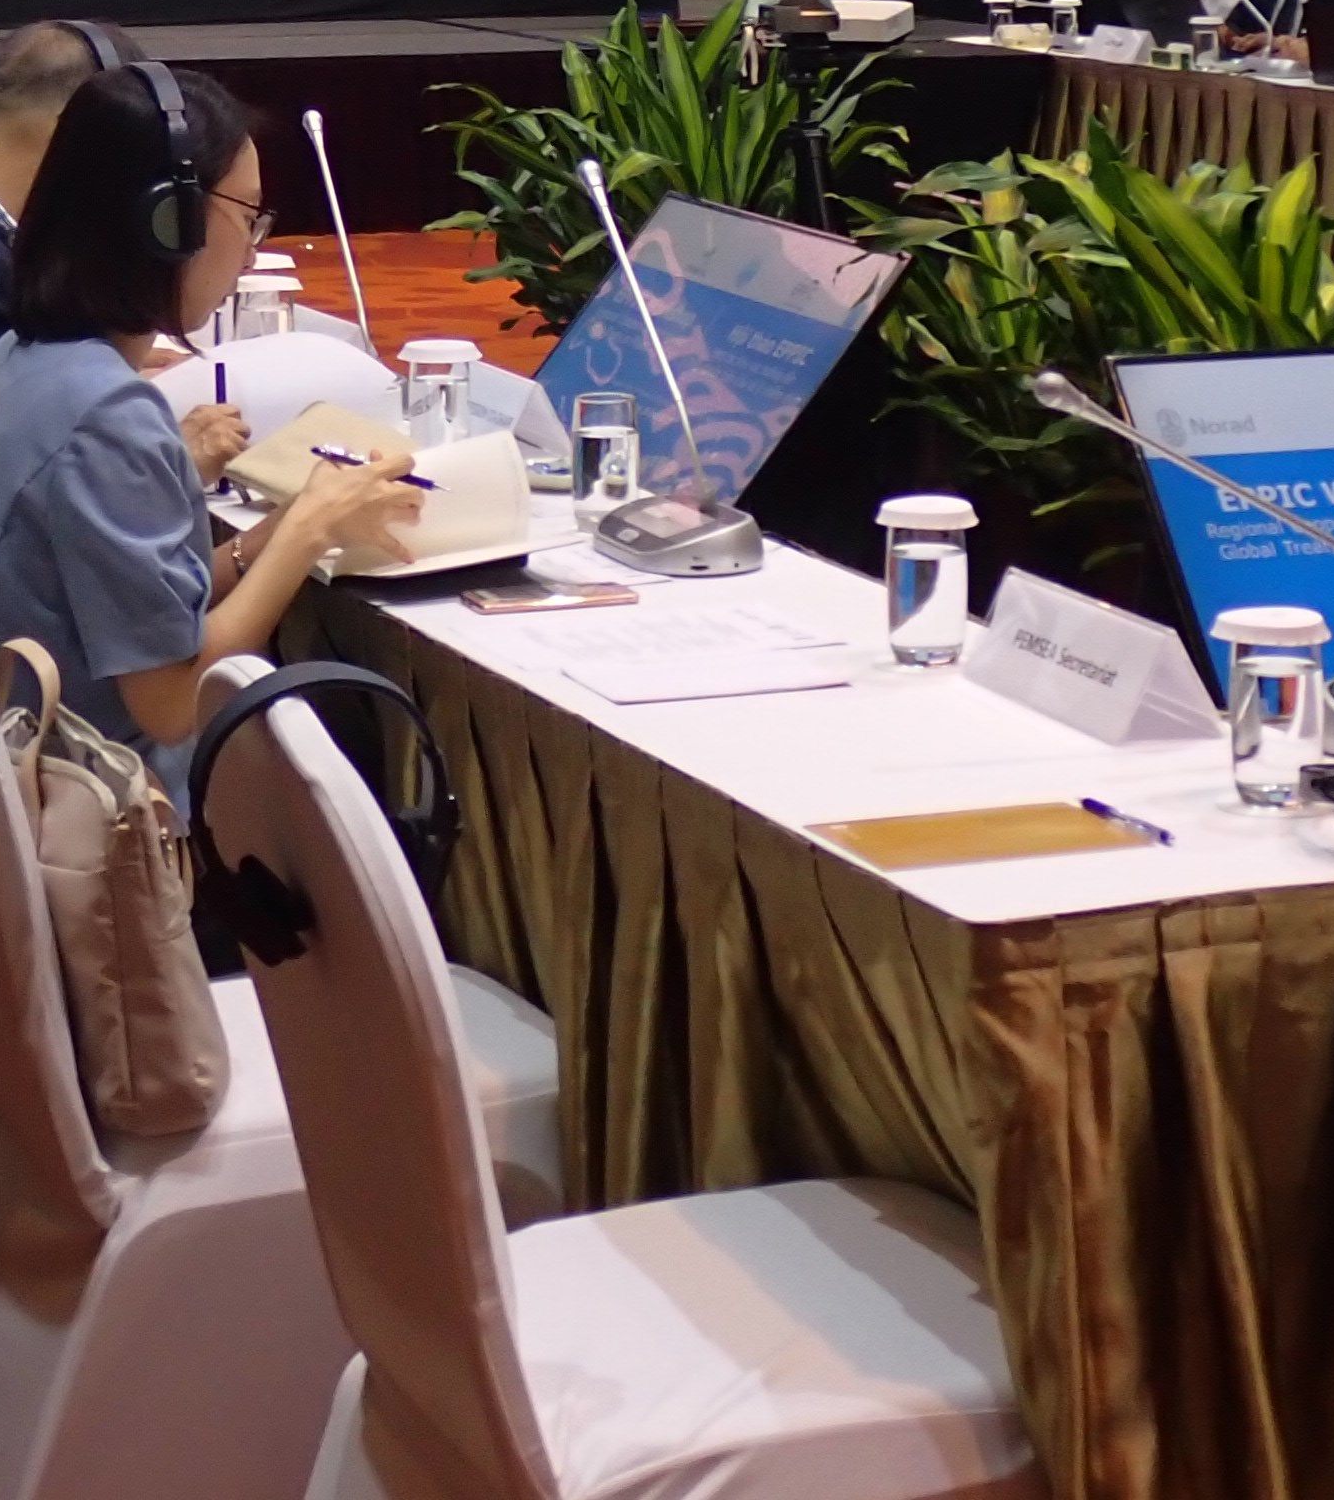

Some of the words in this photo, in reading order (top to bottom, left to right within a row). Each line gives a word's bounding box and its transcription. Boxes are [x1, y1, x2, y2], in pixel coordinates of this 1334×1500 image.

[1190, 415, 1256, 436] Norad
[1205, 521, 1283, 541] Regional
[1219, 541, 1276, 561] Global
